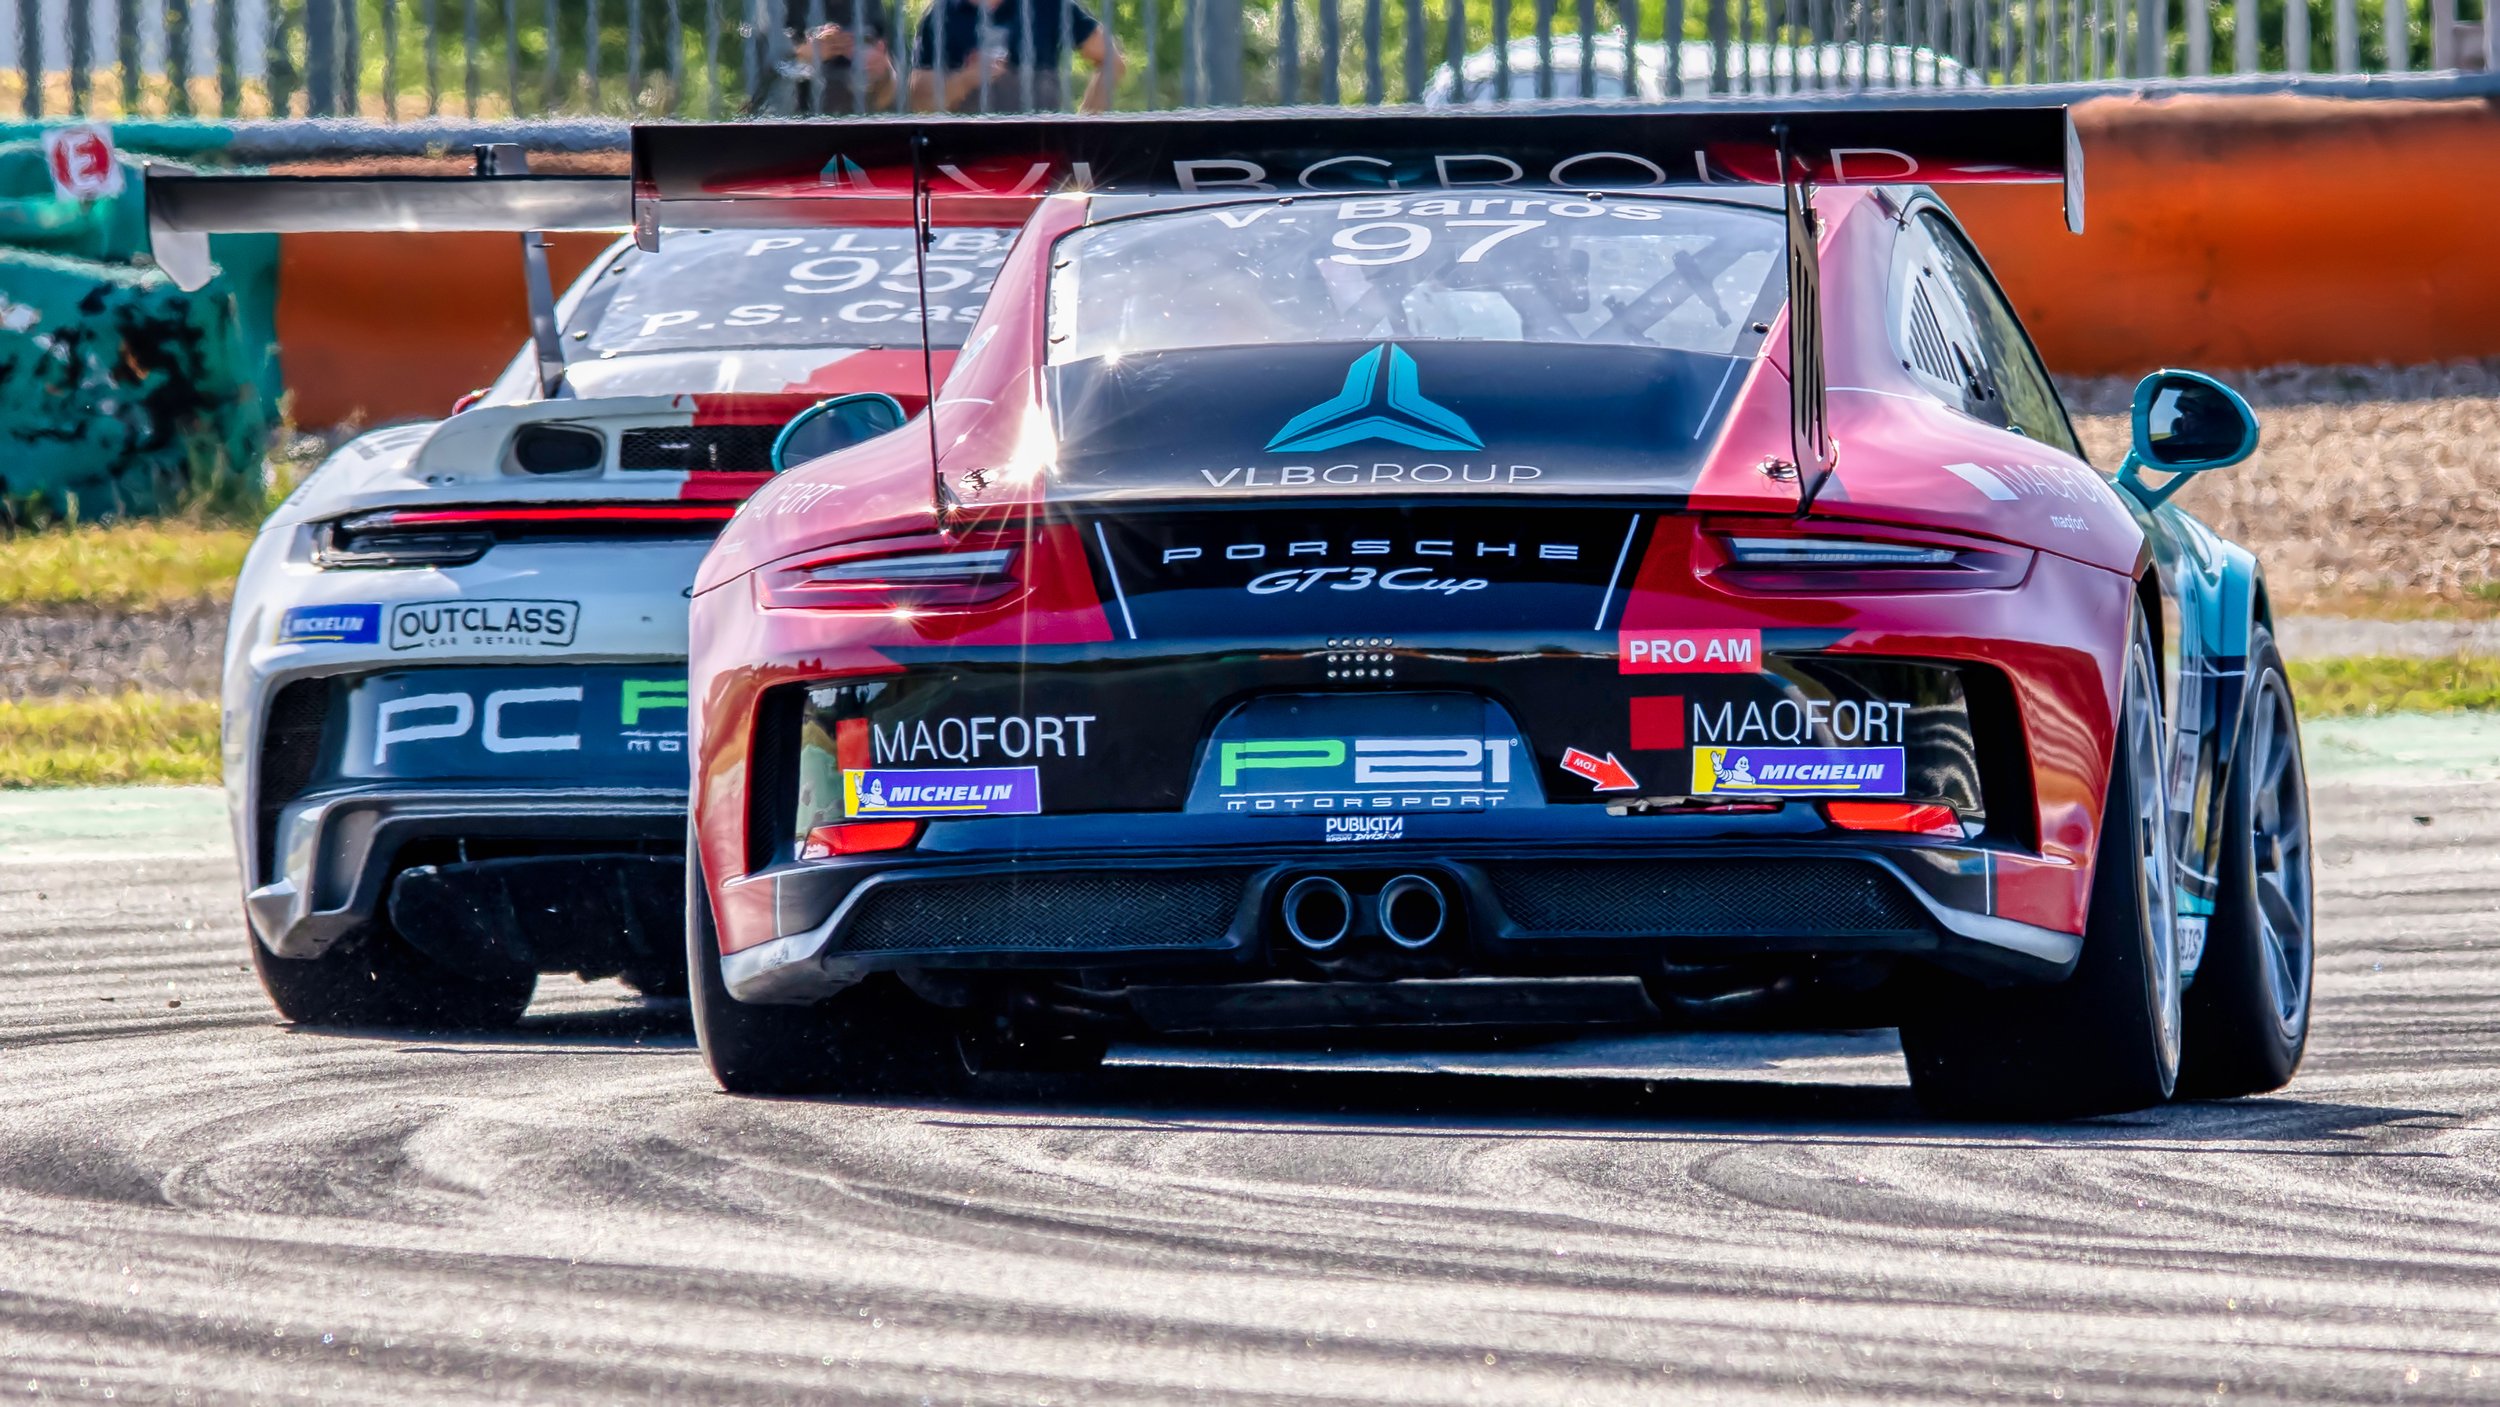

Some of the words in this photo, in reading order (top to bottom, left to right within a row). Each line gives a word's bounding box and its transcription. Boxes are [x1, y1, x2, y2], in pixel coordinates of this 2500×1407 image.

[1211, 207, 1297, 229] V.
[1338, 199, 1663, 220] Barros
[937, 231, 1013, 251] B
[1330, 219, 1546, 265] 97
[639, 304, 801, 337] P.S.
[1201, 463, 1542, 488] VLBGROUP
[1163, 540, 1579, 564] PORSCHE
[291, 616, 365, 633] MICHELIN
[400, 607, 566, 637] OUTCLASS
[428, 636, 458, 648] CAR
[473, 635, 532, 647] DETAIL
[1630, 639, 1696, 663] PRO
[1704, 638, 1752, 663] AM
[374, 686, 583, 765] PC
[1693, 700, 1911, 745] MAQFORT
[874, 715, 1096, 764] MAQFORT
[1573, 758, 1597, 773] TOW
[1759, 764, 1885, 780] MICHELIN
[888, 784, 1013, 803] MICHELIN
[1227, 796, 1505, 811] MOTORSPORT
[1326, 816, 1404, 833] PUBLICITA
